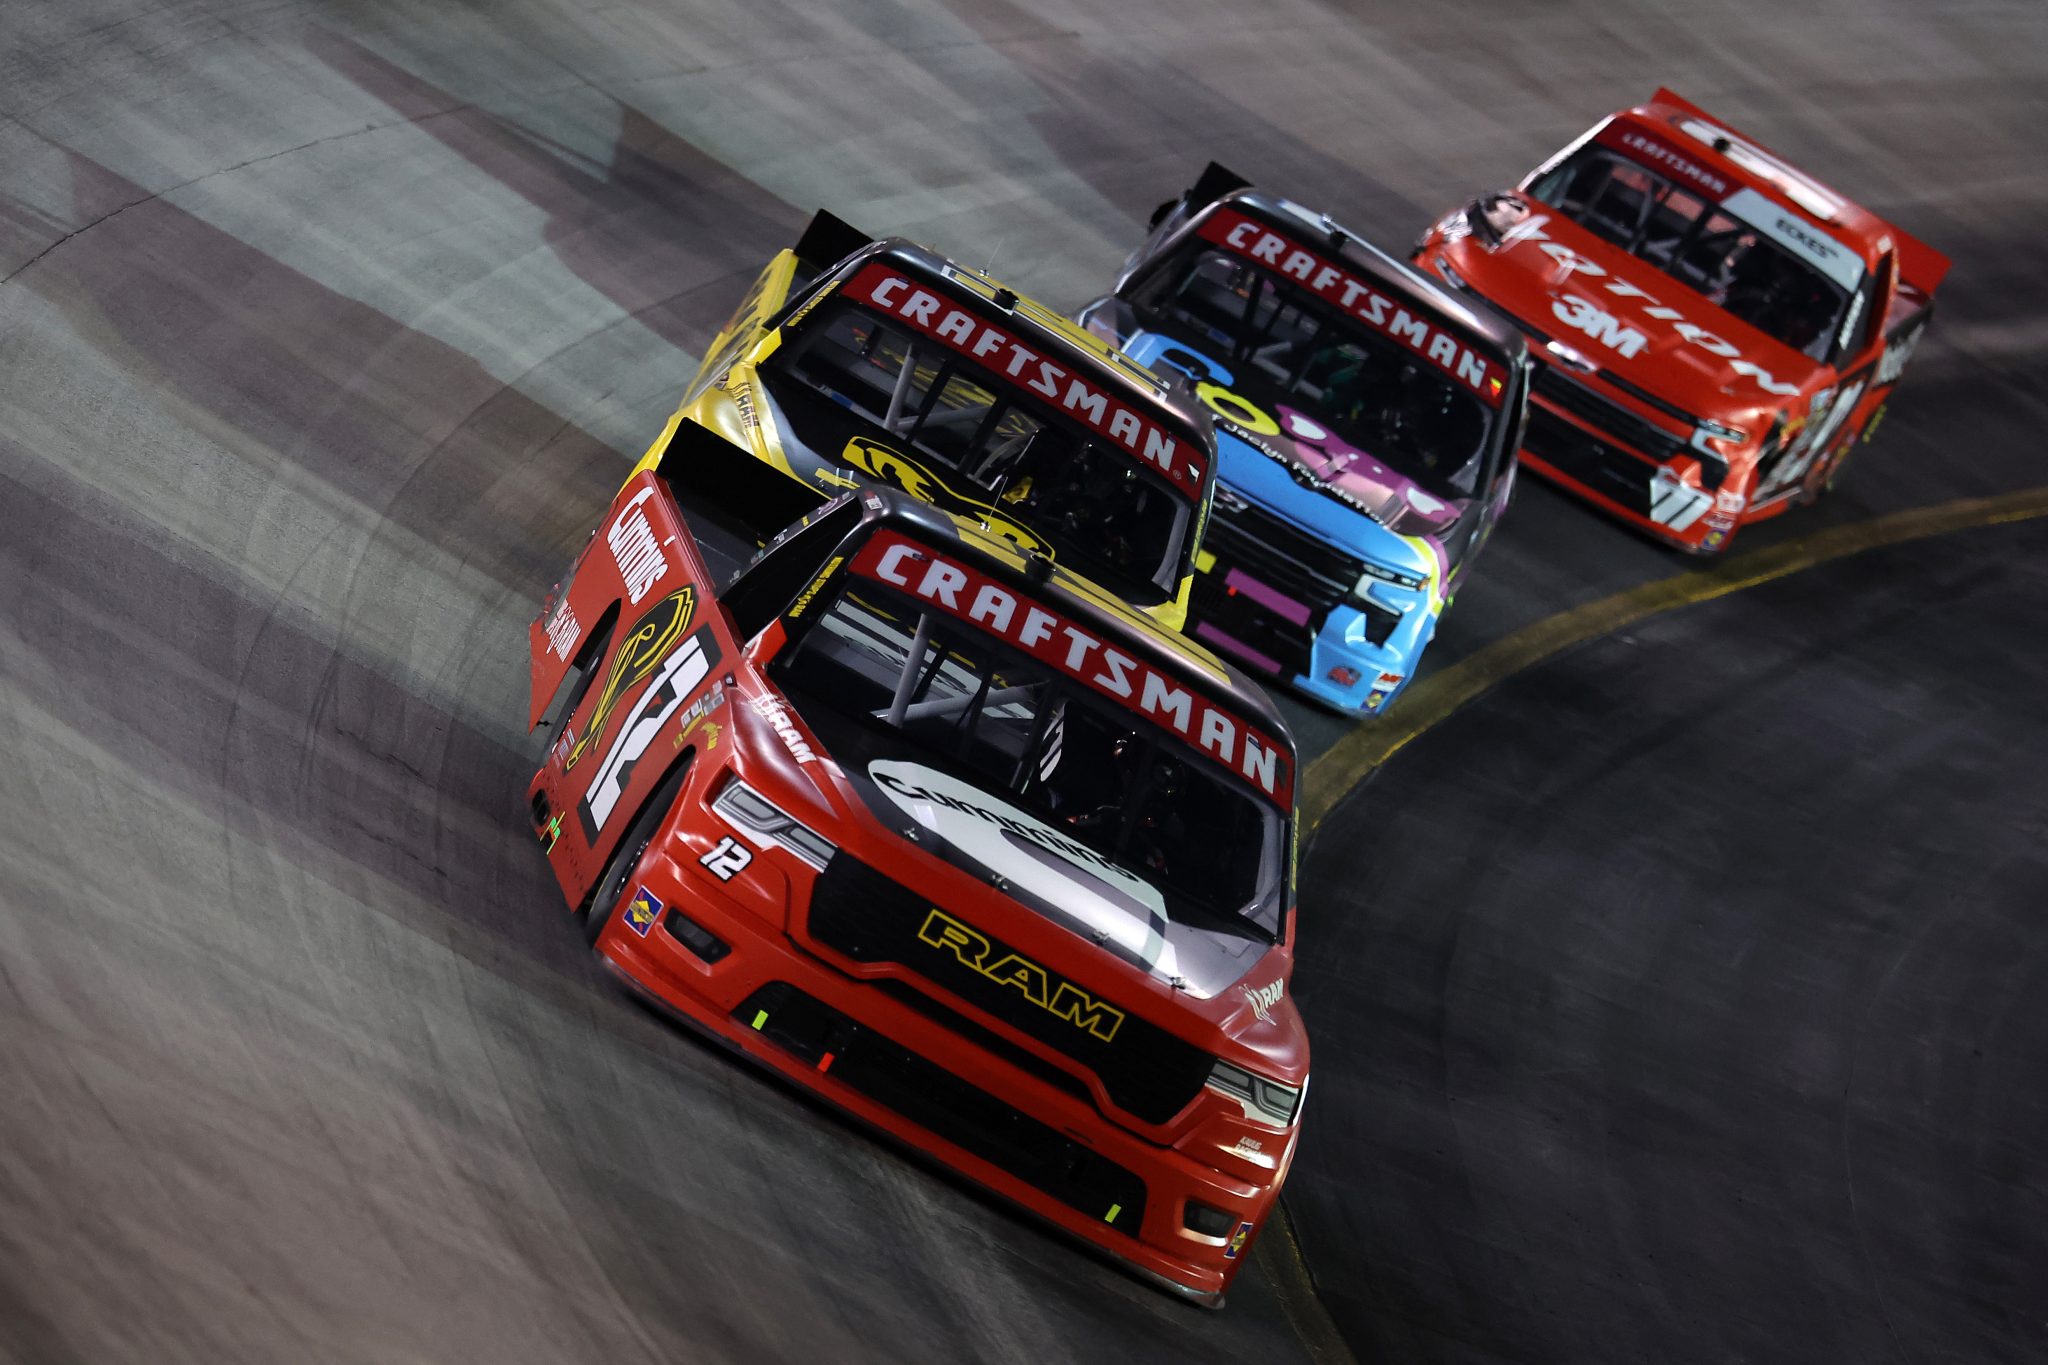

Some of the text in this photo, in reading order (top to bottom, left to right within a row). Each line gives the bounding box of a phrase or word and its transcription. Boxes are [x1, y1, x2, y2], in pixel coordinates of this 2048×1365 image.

[1621, 132, 1727, 194] CRAFTSMAN
[1226, 222, 1487, 389] CRAFTSMAN
[1552, 294, 1649, 360] 3M
[871, 277, 1177, 472] CRAFTSMAN
[607, 486, 668, 605] Cummins
[876, 543, 1277, 795] CRAFTSMAN
[768, 709, 817, 764] RAM
[698, 835, 754, 883] 12
[872, 772, 1139, 882] Cummins
[917, 908, 1126, 1043] RAM
[1259, 977, 1284, 1009] RAM
